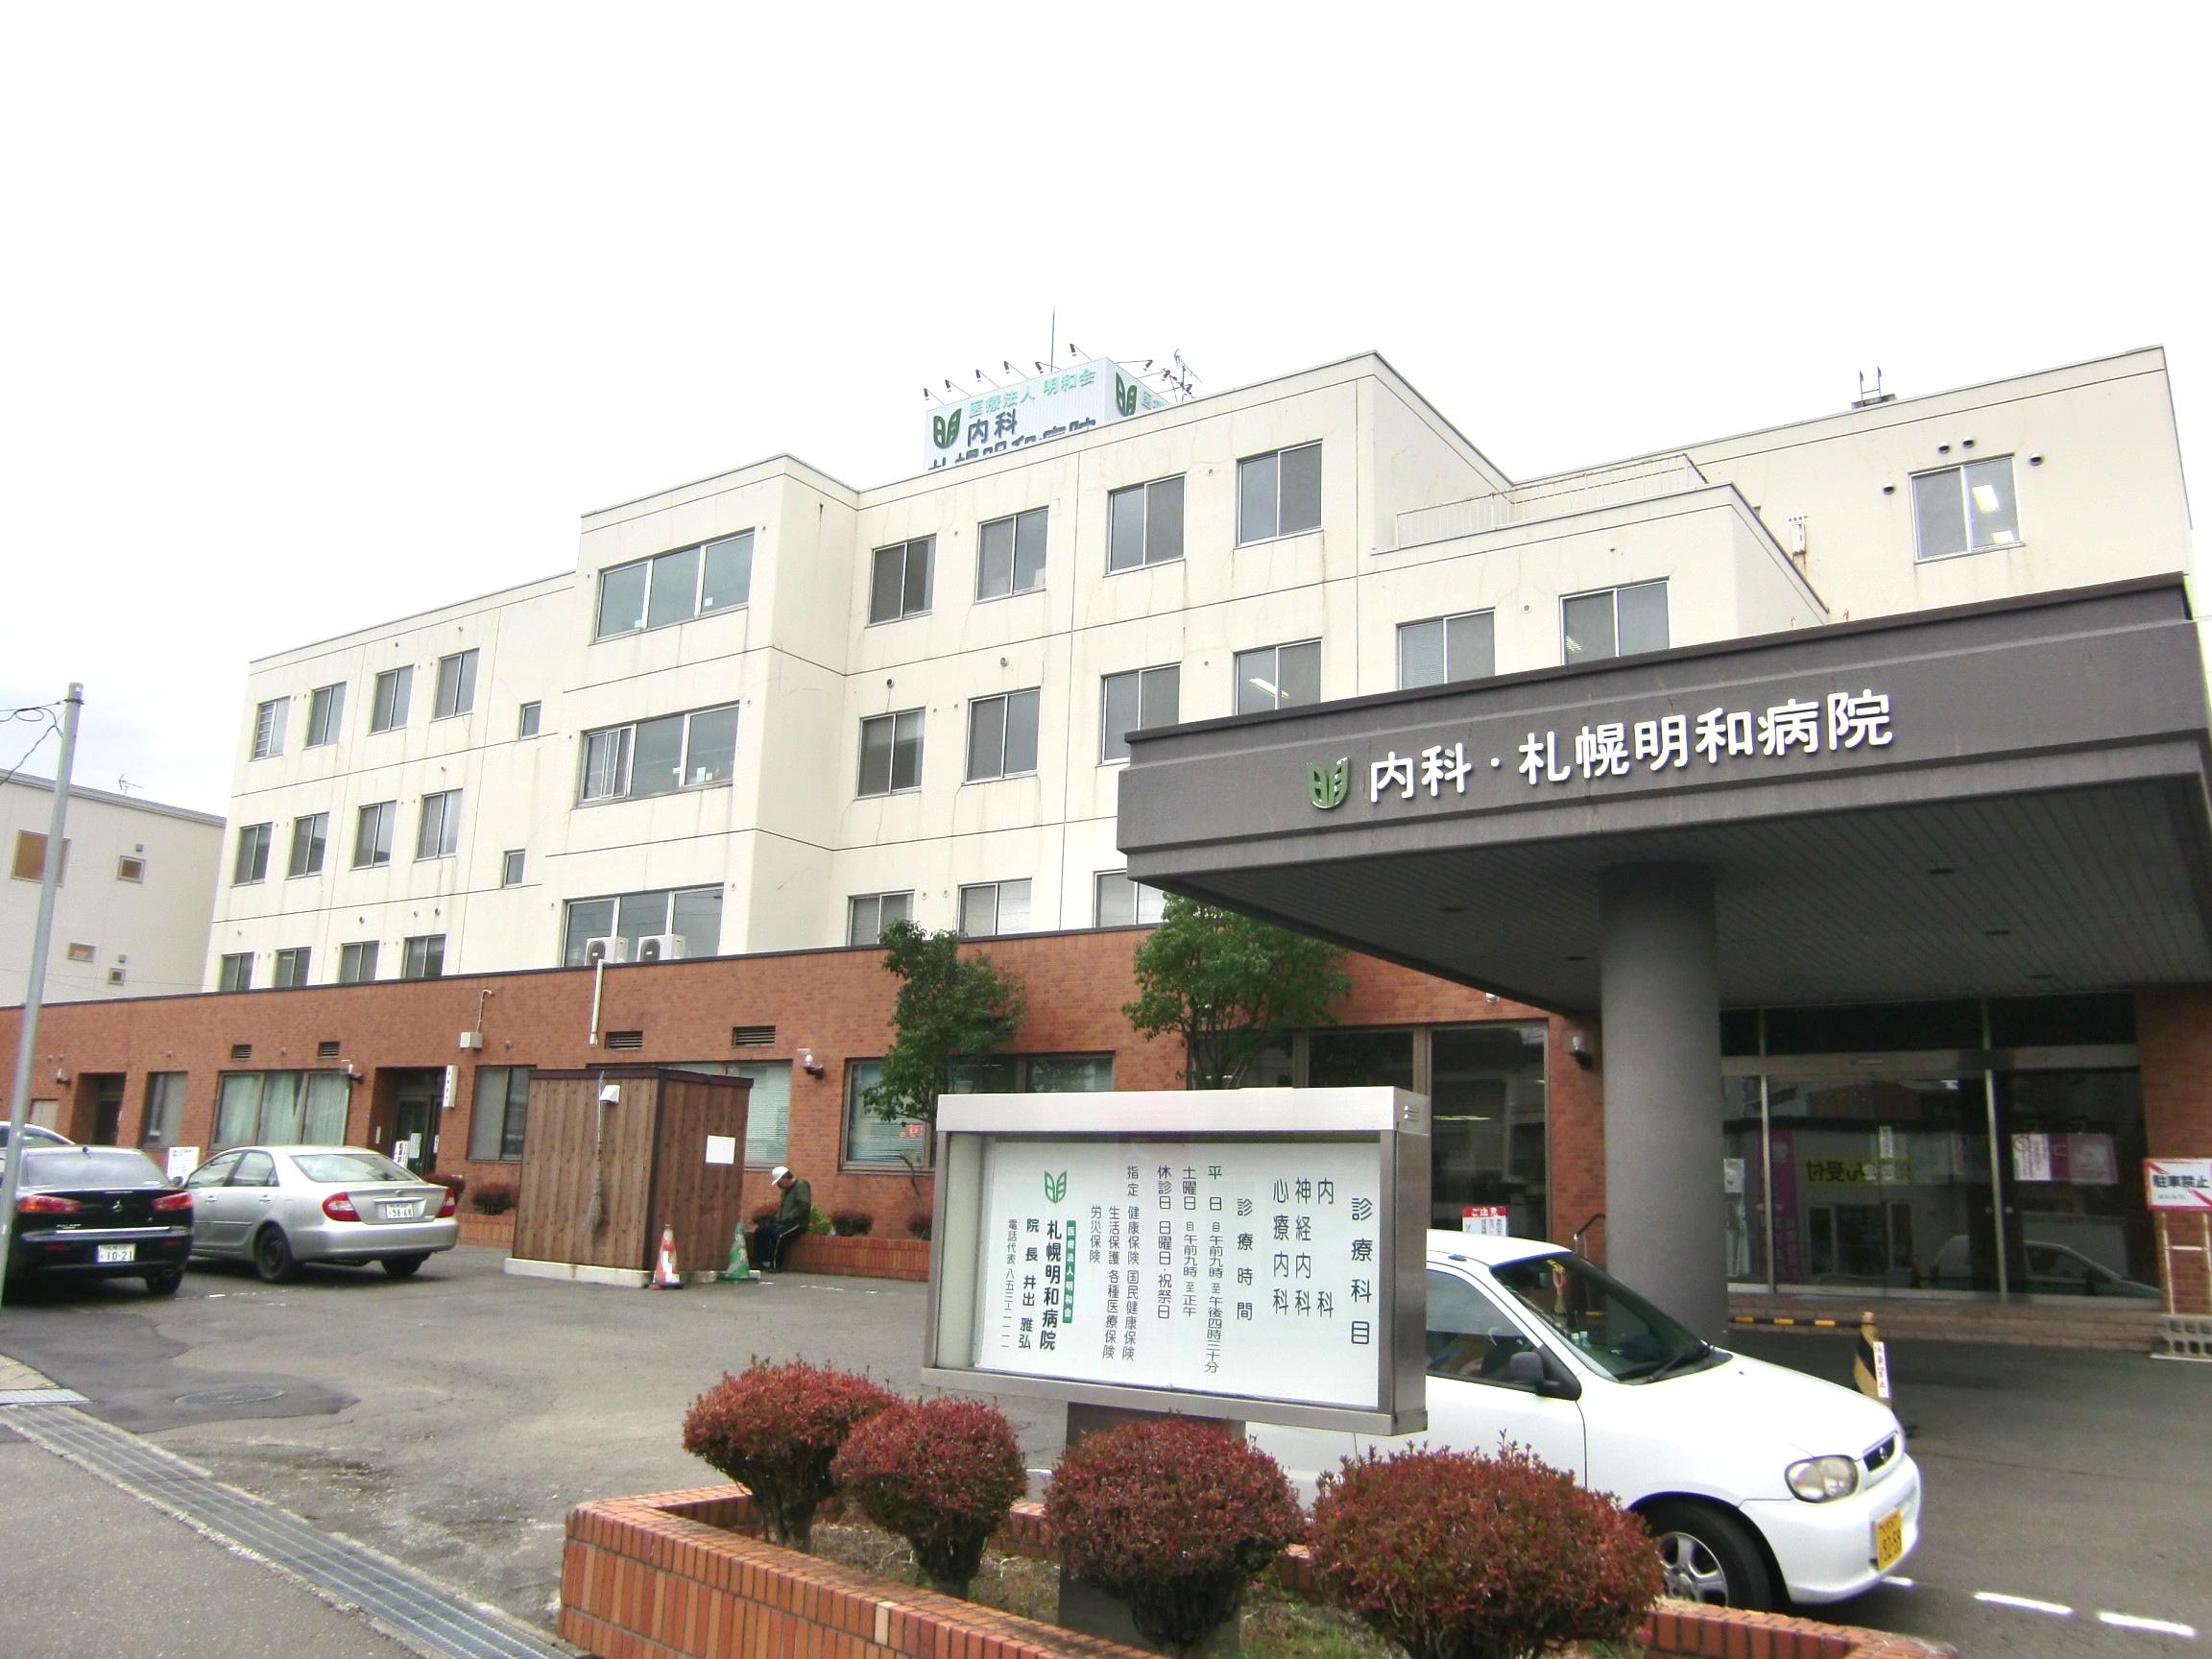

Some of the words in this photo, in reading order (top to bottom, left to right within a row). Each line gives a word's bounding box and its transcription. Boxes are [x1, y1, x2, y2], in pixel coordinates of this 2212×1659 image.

[969, 382, 1036, 419] 医療法人
[1043, 369, 1095, 397] 明和会
[967, 408, 1018, 447] 内科
[1368, 687, 1895, 804] 内科・札幌明和病院
[1127, 1165, 1140, 1197] 指定
[1157, 1165, 1172, 1210] 休診日
[1182, 1166, 1197, 1211] 土曜日
[1208, 1166, 1222, 1212] 平日
[2152, 1174, 2210, 1188] 駐車禁止
[1024, 1217, 1040, 1262] 院長
[1089, 1204, 1102, 1264] 労災保険
[1108, 1205, 1120, 1265] 生活保護
[1127, 1205, 1141, 1265] 健康保険
[1471, 1207, 1498, 1216] ご注意
[107, 1250, 132, 1261] 10-21
[1064, 1226, 1075, 1318] 医療法人明和会
[1157, 1220, 1172, 1319] 日曜日・祝祭日
[1237, 1197, 1254, 1321] 診療時間
[1272, 1177, 1289, 1315] 心療内科
[1294, 1177, 1311, 1317] 神経内科
[1317, 1177, 1334, 1318] 内科
[1351, 1197, 1373, 1345] 診療科目
[1040, 1219, 1063, 1351] 札幌明和病院
[1102, 1269, 1120, 1359] 各種医療保険
[1121, 1269, 1141, 1361] 国民健康保険
